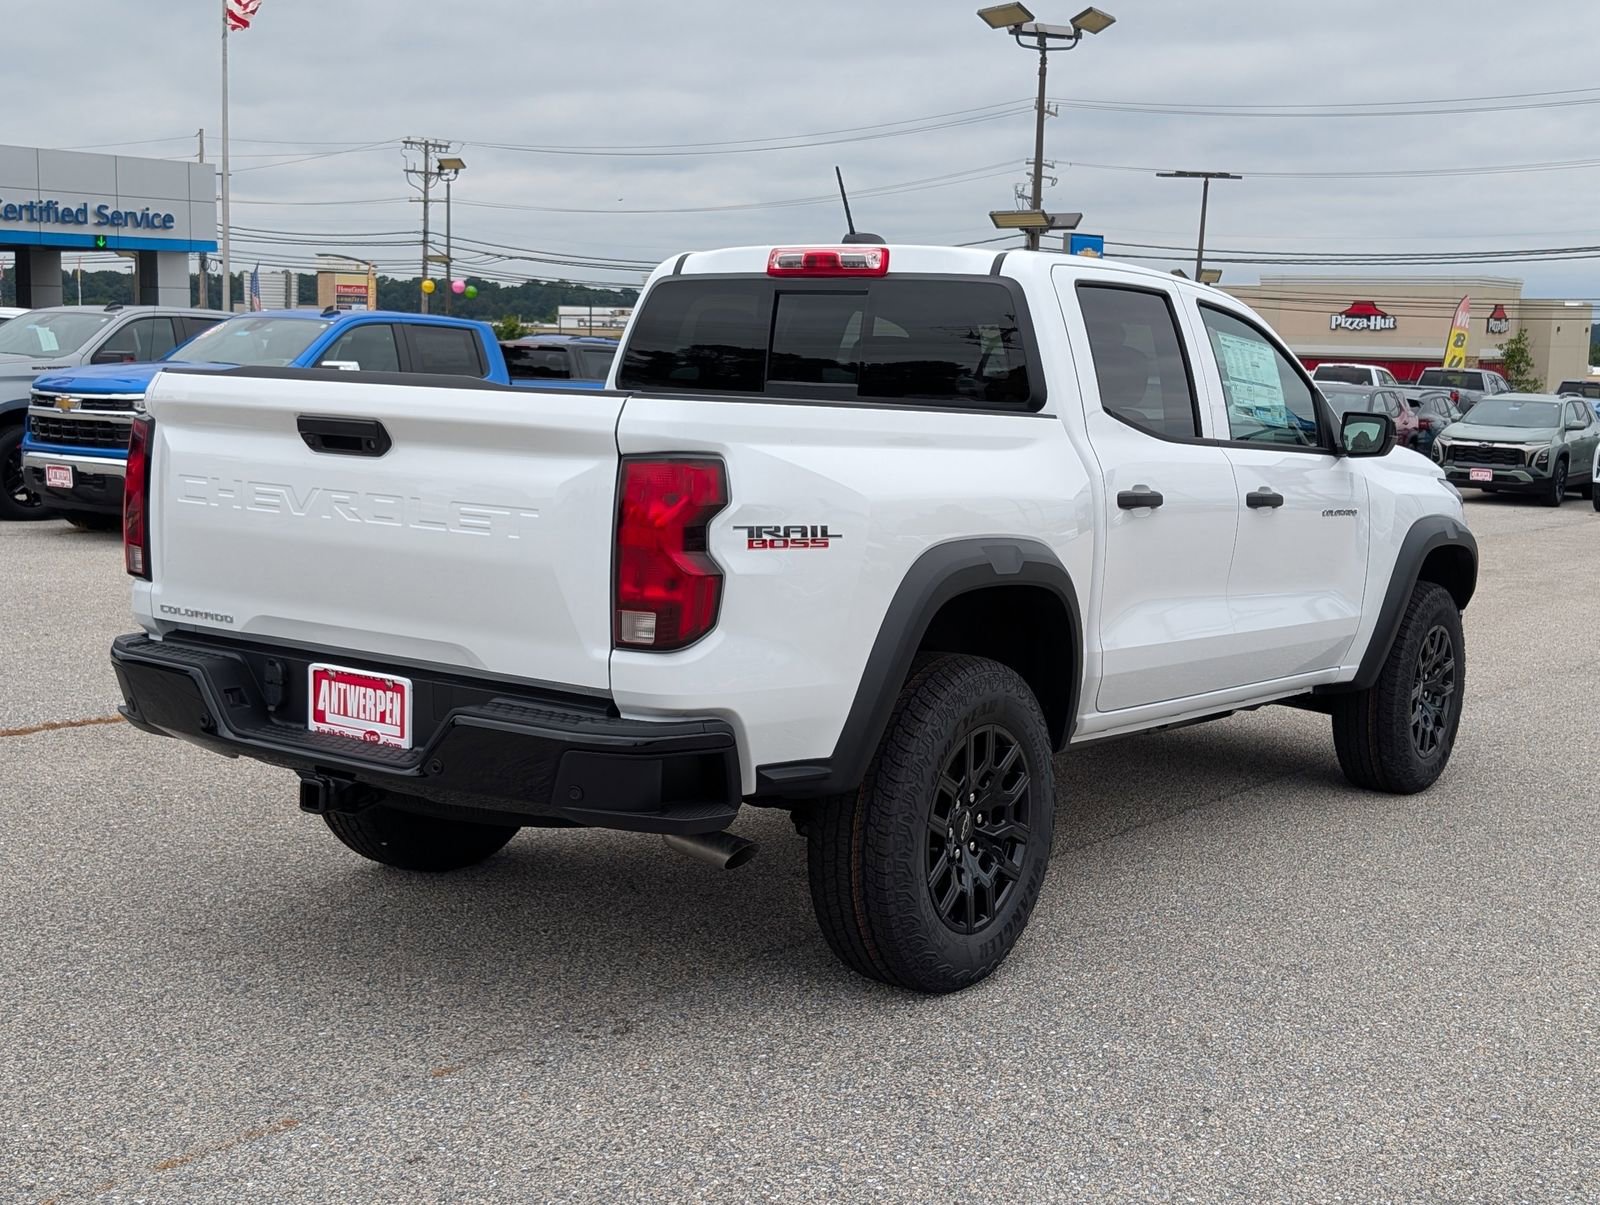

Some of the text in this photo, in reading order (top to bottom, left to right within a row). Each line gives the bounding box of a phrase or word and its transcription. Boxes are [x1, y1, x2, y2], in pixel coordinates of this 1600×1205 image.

[0, 200, 175, 230] ertified Service
[1330, 314, 1395, 330] Pizza Hut
[177, 474, 539, 539] CHEVROLET
[732, 526, 842, 538] TRAIL
[747, 538, 829, 550] BOSS
[160, 604, 234, 624] COLORADO
[317, 679, 401, 727] ANTWERPEN
